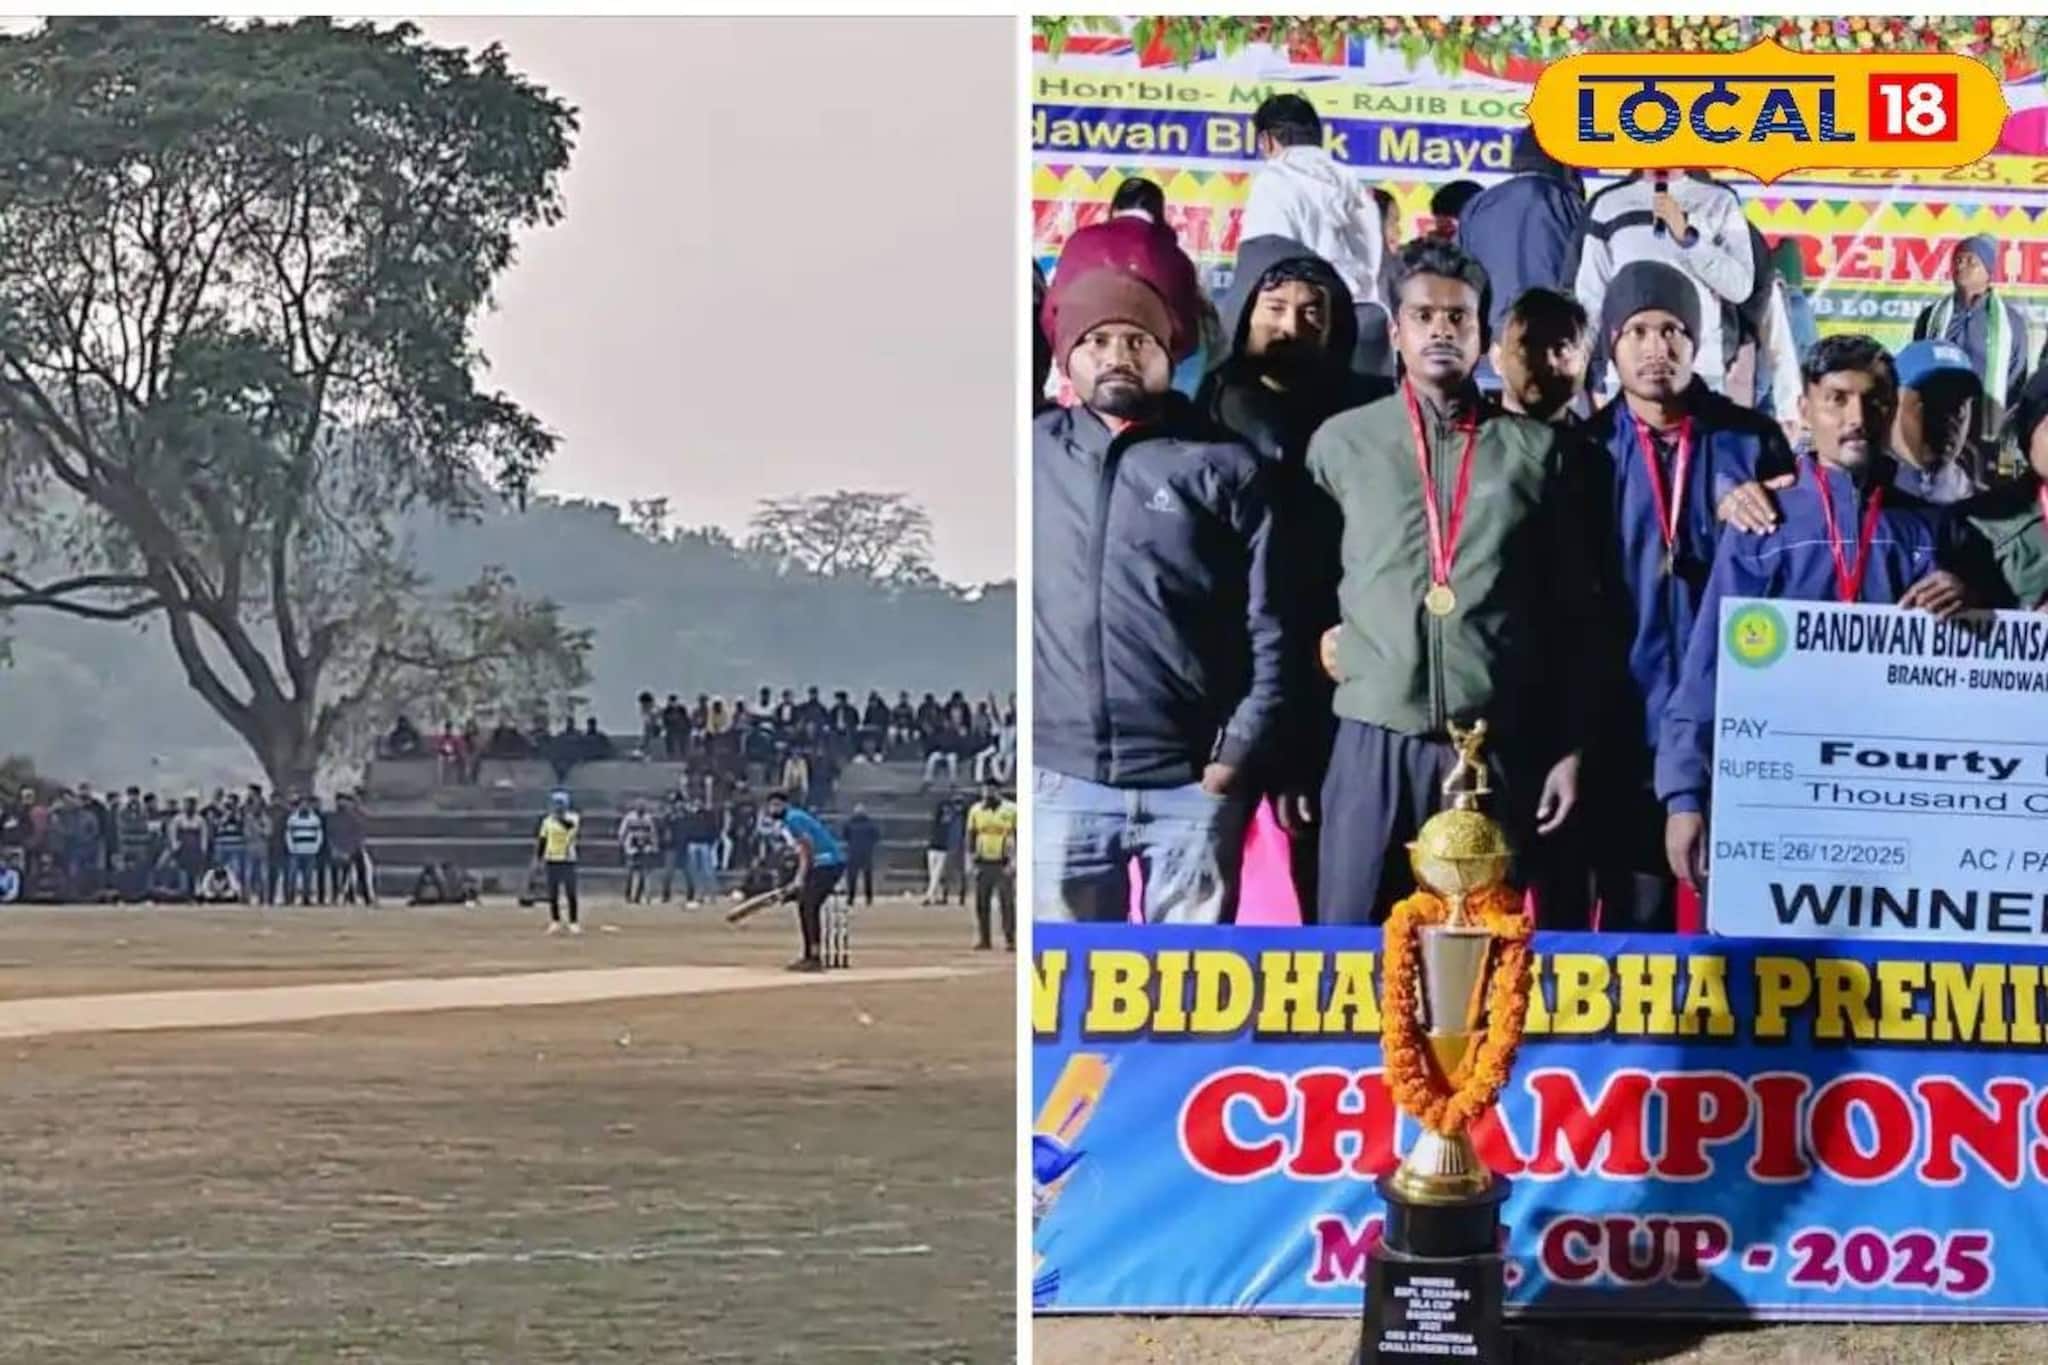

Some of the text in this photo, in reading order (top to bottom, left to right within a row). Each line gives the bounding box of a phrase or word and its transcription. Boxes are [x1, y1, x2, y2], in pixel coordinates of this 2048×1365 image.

[1354, 93, 1447, 115] RAJIB
[1796, 611, 1926, 655] BANDWAN
[1887, 664, 1957, 687] BRANCH
[1969, 669, 2048, 693] BUNDWA
[1721, 718, 1768, 738] PAY
[1718, 759, 1795, 781] RUPEES
[1820, 741, 2022, 780] Fourty
[1804, 781, 2007, 811] Thousand
[1716, 841, 1906, 865] DATE 26/12/2025
[1958, 848, 1998, 870] AC
[1769, 883, 2048, 935] WINNE
[1754, 956, 2048, 1044] PREMI
[1542, 1218, 1730, 1285] CUP
[1792, 1232, 1990, 1293] 2025
